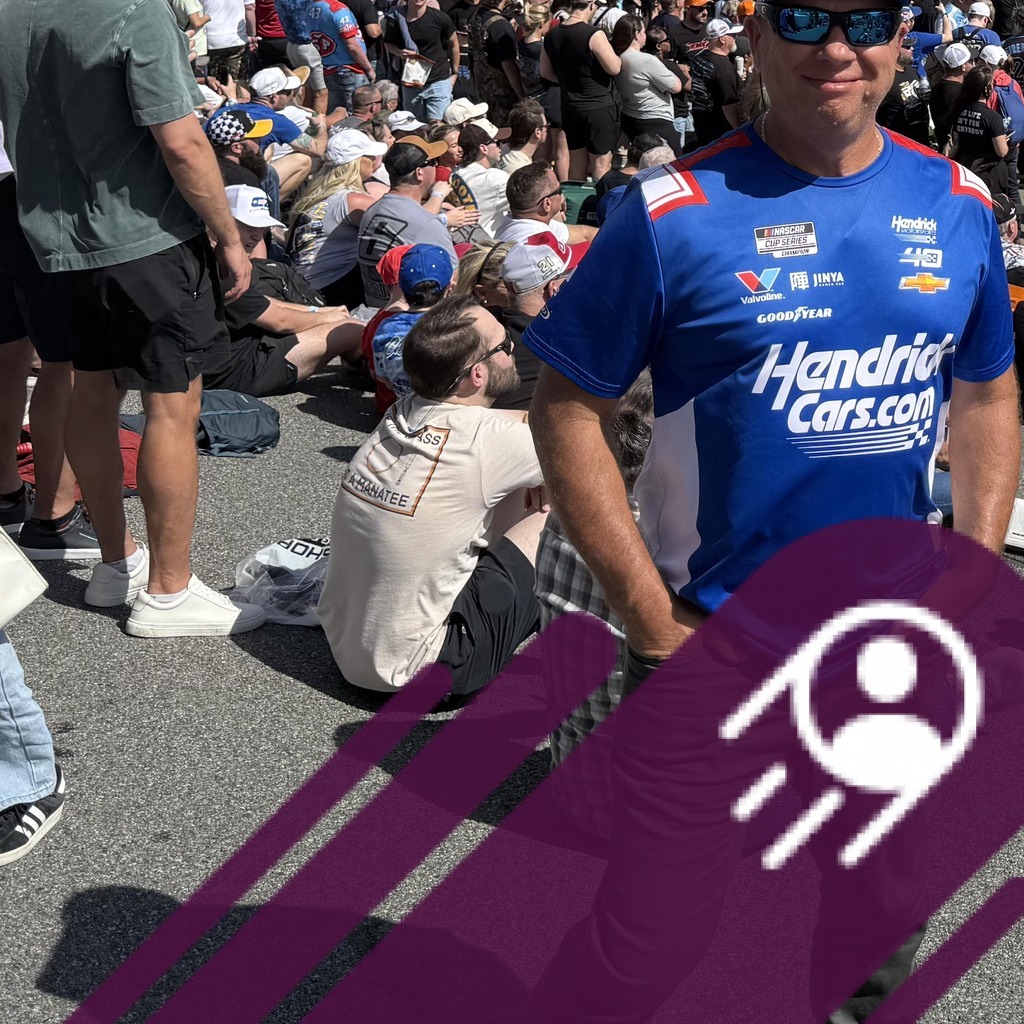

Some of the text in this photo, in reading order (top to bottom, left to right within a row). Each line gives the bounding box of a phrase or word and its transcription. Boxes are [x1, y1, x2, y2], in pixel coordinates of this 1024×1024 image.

[309, 7, 322, 20] 43
[772, 224, 805, 236] NASCAR
[891, 215, 938, 231] Hendrick
[765, 236, 808, 247] CUP SERIES
[536, 255, 555, 274] 21
[813, 271, 844, 287] JINYA
[787, 386, 935, 434] Cars.com
[354, 474, 410, 507] MANATEE
